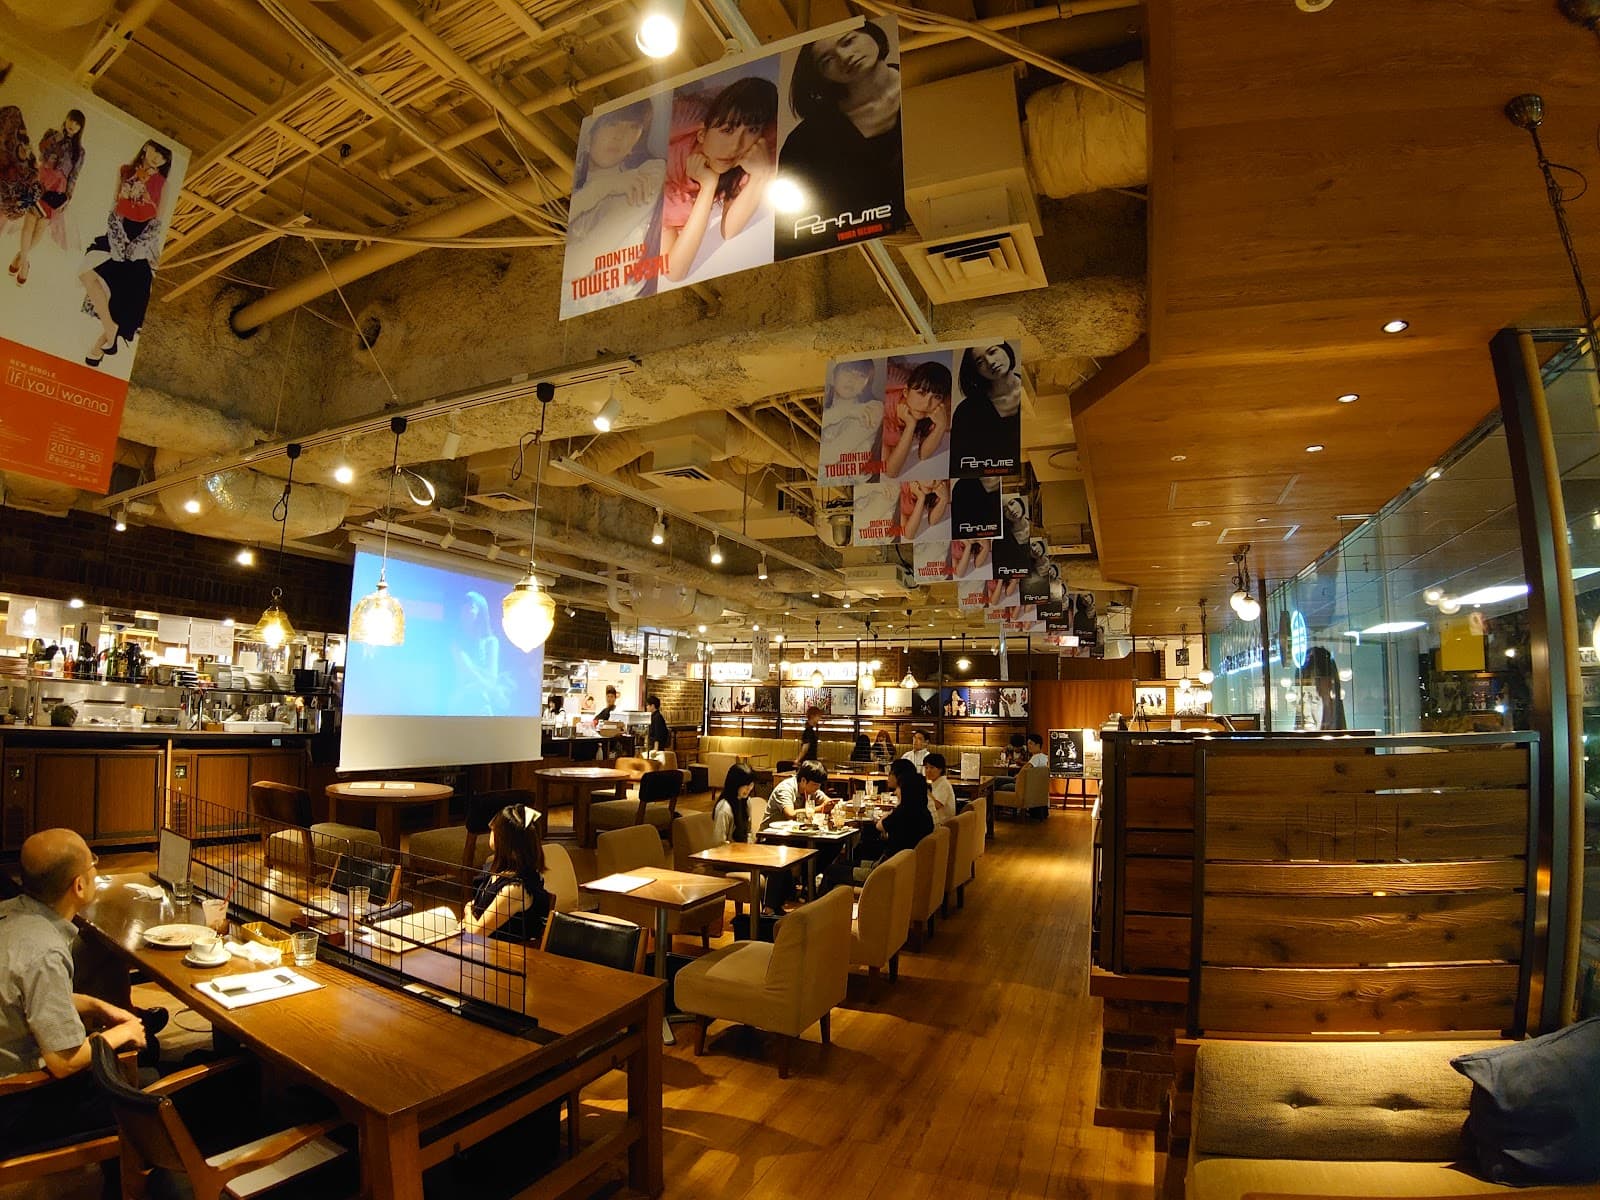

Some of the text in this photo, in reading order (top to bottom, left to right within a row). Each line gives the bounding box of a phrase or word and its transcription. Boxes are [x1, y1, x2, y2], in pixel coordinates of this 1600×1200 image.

[794, 204, 892, 239] Perfume
[595, 243, 647, 271] MONTHLY
[571, 268, 619, 300] TOWER
[61, 389, 108, 413] wanna
[825, 462, 857, 478] TOWER
[960, 456, 1014, 470] Perfume
[960, 523, 998, 533] Perfume
